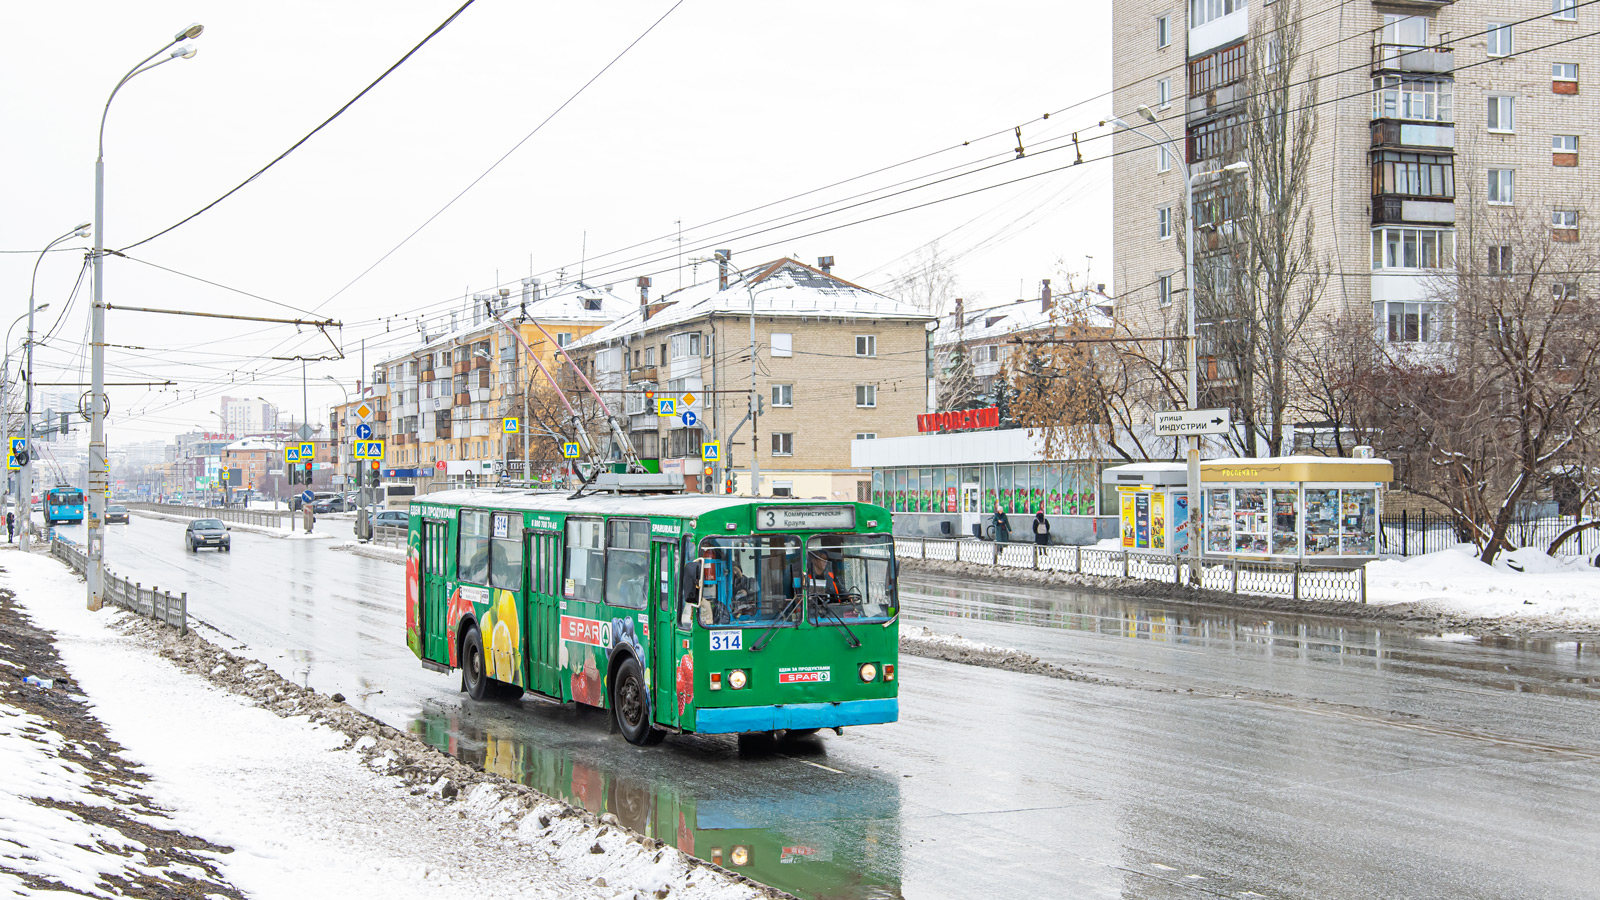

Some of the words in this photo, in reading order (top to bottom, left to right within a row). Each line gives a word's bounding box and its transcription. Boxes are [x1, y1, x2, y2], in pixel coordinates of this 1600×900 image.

[917, 403, 999, 432] КИРОВСКИЙ
[1160, 415, 1182, 423] улица
[1159, 422, 1207, 431] ИНДУСТРИИ
[1222, 469, 1258, 477] РОСПЕЧАТЬ
[496, 516, 507, 531] 314
[766, 511, 776, 527] 3
[569, 621, 600, 640] SPAR
[712, 635, 741, 650] 314
[788, 673, 818, 681] SPAR
